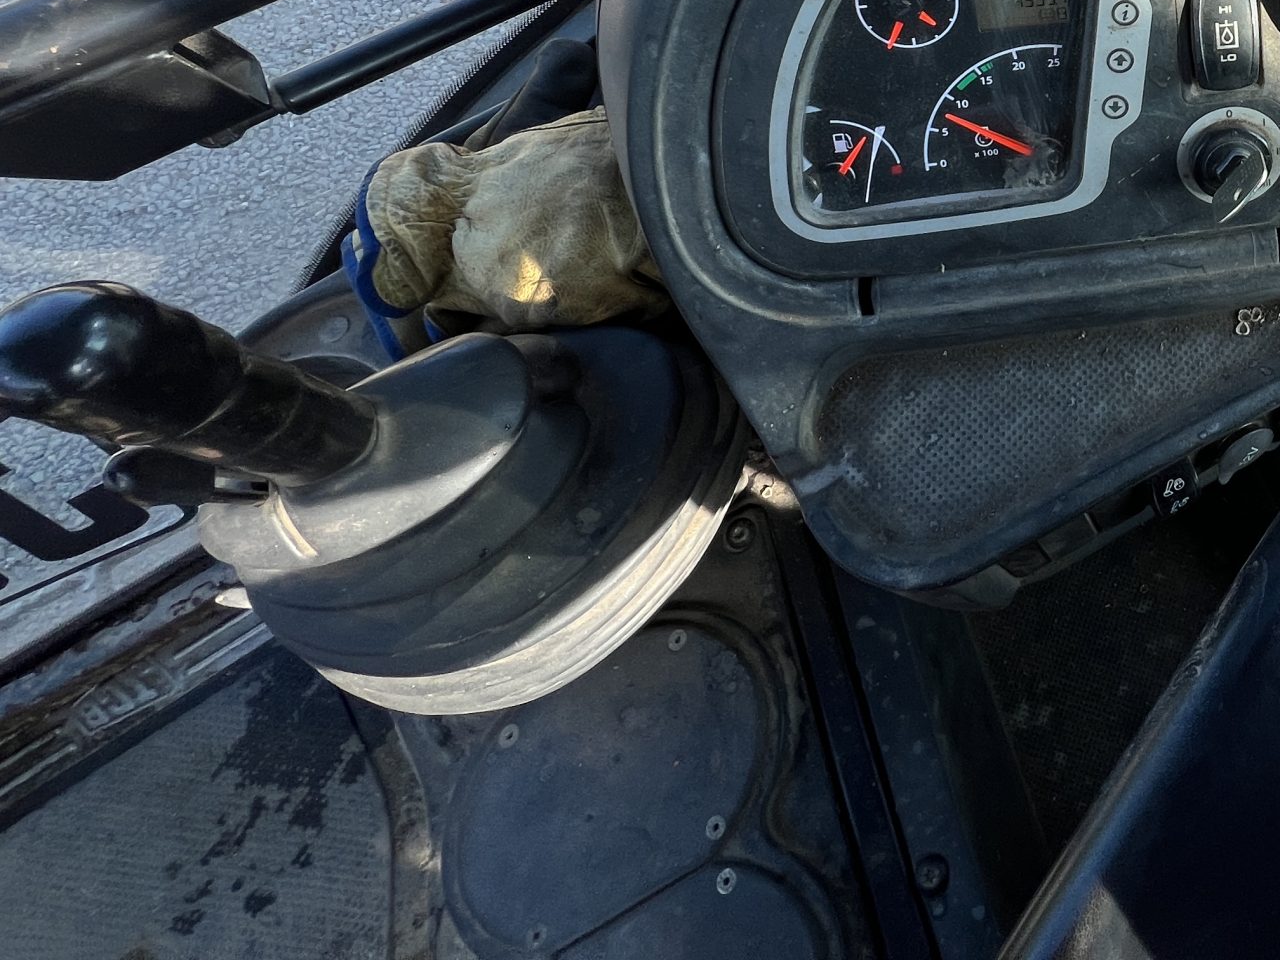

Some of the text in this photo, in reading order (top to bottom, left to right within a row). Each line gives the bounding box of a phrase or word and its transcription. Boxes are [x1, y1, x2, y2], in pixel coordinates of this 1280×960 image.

[1218, 4, 1233, 15] HI
[1220, 53, 1237, 63] LO
[1011, 57, 1061, 71] 20 25
[979, 75, 993, 86] 15
[955, 98, 969, 109] 10
[1226, 109, 1233, 118] 0
[941, 127, 949, 137] 5
[982, 147, 999, 158] 100
[940, 158, 948, 168] 0
